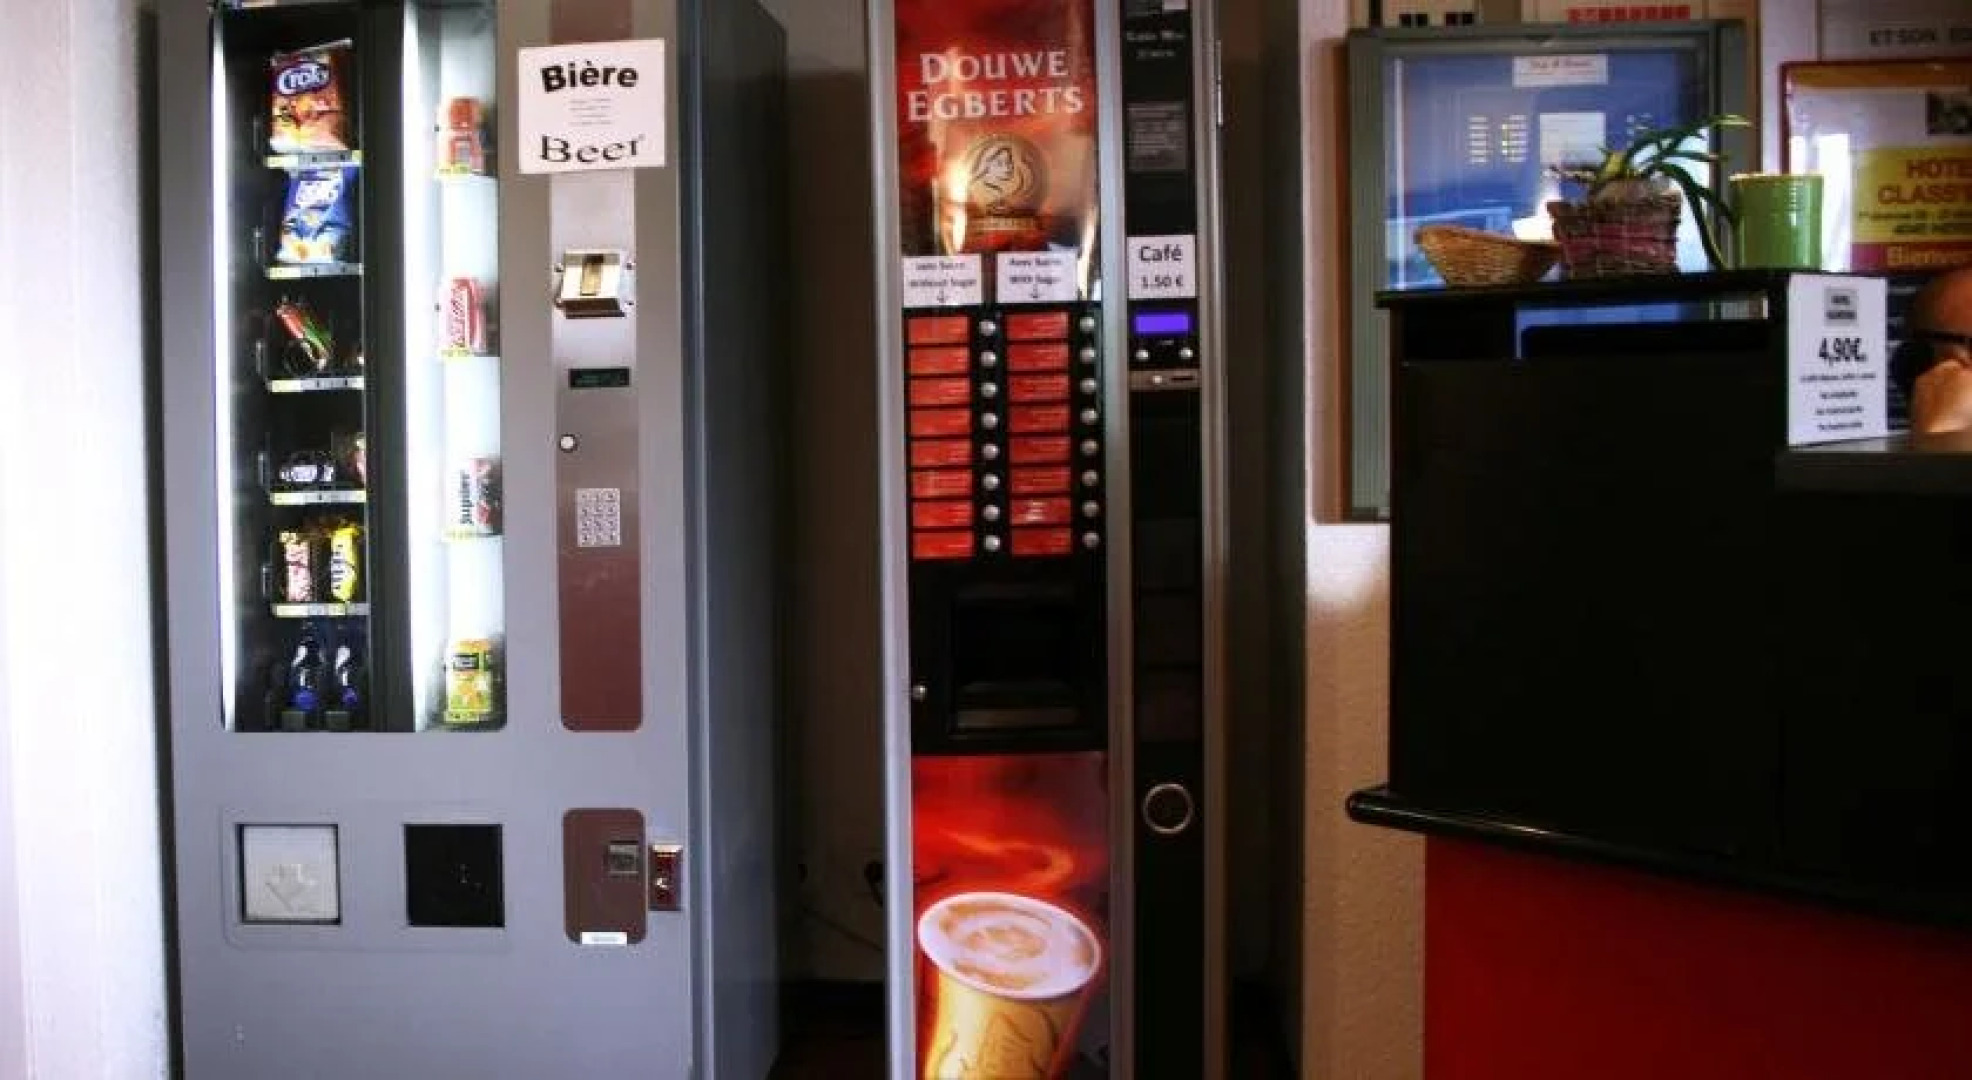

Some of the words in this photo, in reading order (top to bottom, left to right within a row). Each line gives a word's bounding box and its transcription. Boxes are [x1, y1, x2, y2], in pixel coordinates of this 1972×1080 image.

[540, 60, 639, 93] Bière
[920, 50, 1069, 84] DOUWE
[907, 86, 1084, 122] EGBERTS
[540, 133, 645, 163] Beer
[1139, 244, 1184, 263] Café
